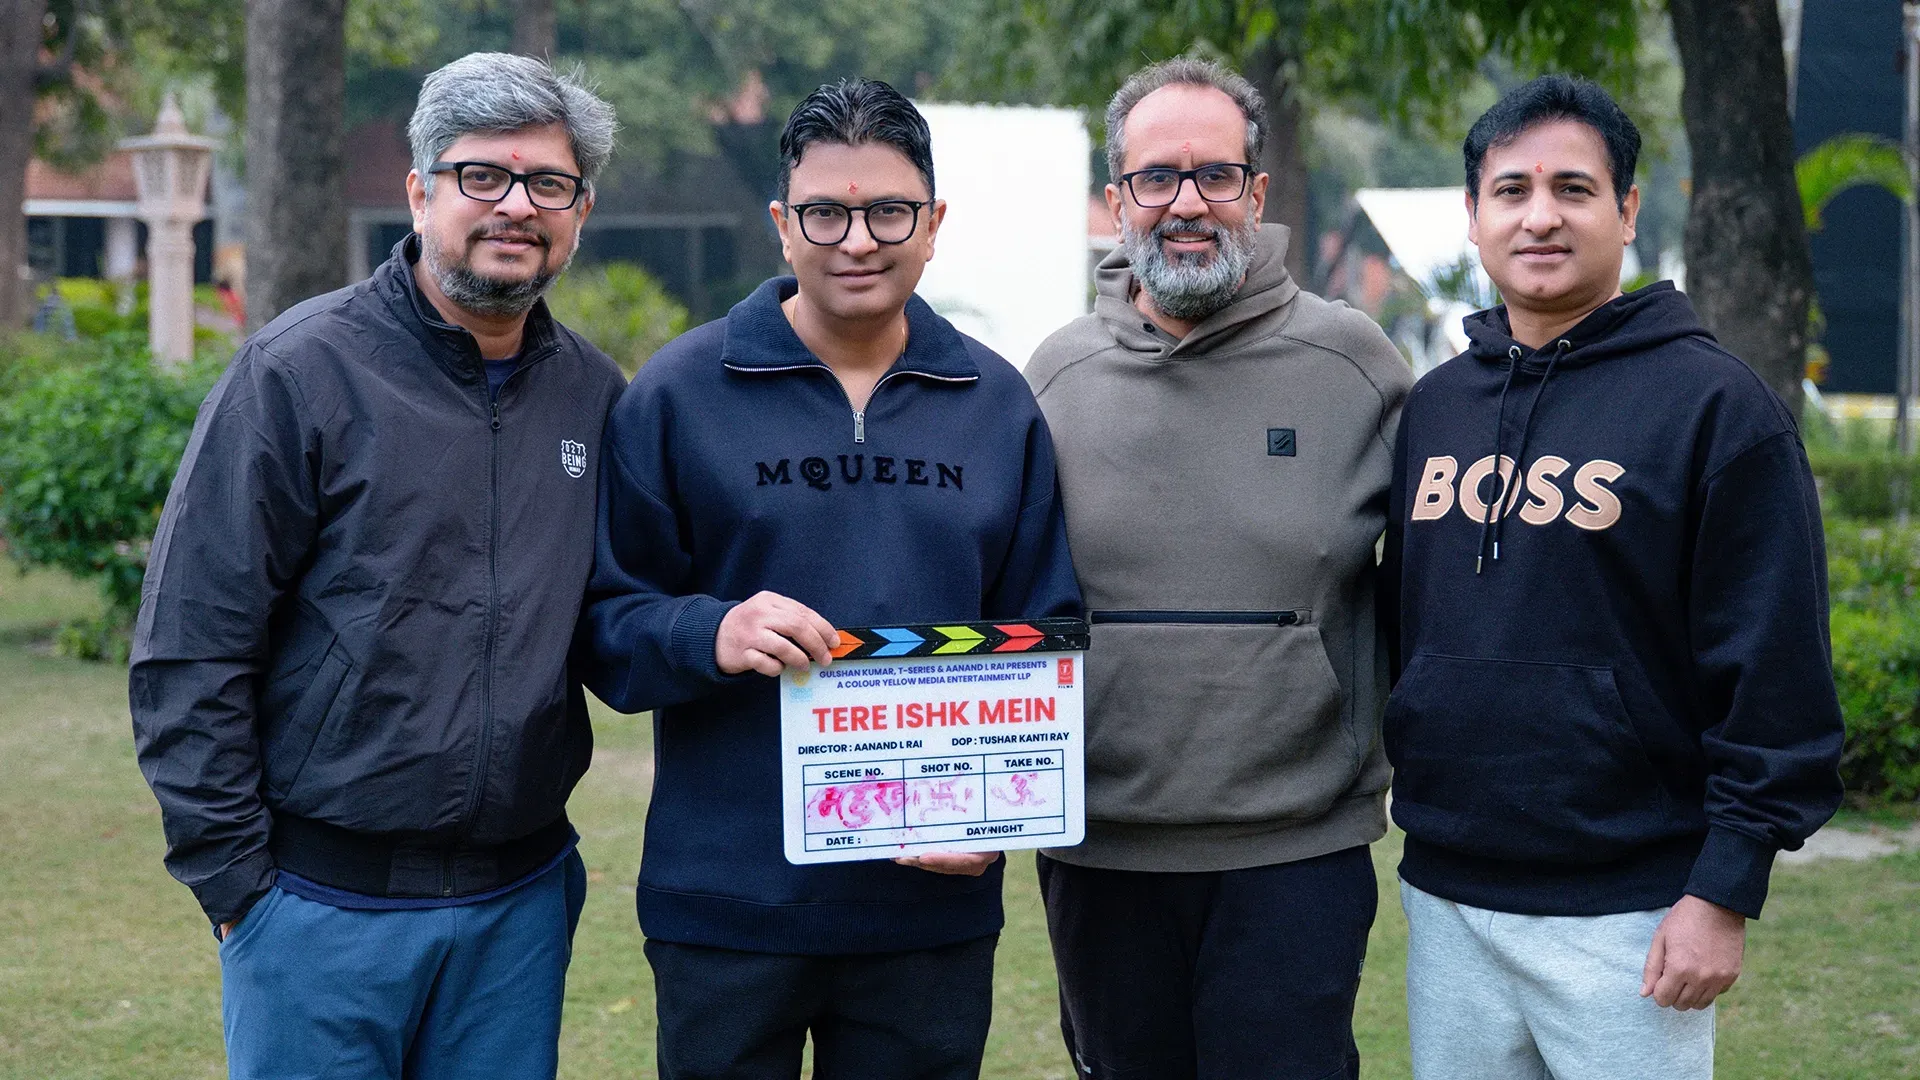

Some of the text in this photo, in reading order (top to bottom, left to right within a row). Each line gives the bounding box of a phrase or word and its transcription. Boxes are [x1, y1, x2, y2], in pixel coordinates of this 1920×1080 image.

[561, 452, 587, 469] BEING
[1411, 454, 1626, 531] BOSS
[819, 660, 1047, 679] GULSHAN KUMAR, T-SERIES & AANAND L RAI PRESENTS
[836, 672, 1031, 689] A COLOUR YELLOW MEDIA ENTERTAINMENT LLP
[812, 696, 1056, 733] TERE ISHK MEIN
[952, 737, 973, 747] DOP
[979, 734, 1018, 745] TUSHAR
[1018, 733, 1048, 743] KANTI
[1049, 732, 1070, 741] RAY
[798, 744, 848, 755] DIRECTOR
[854, 741, 898, 752] AANAND
[899, 740, 905, 749] L
[906, 740, 923, 749] RAI
[921, 762, 973, 773] SHOT NO.
[1004, 757, 1055, 768] TAKE NO.
[824, 767, 884, 779] SCENE NO.
[966, 824, 1024, 836] DAY/NIGHT
[826, 836, 855, 846] DATE
